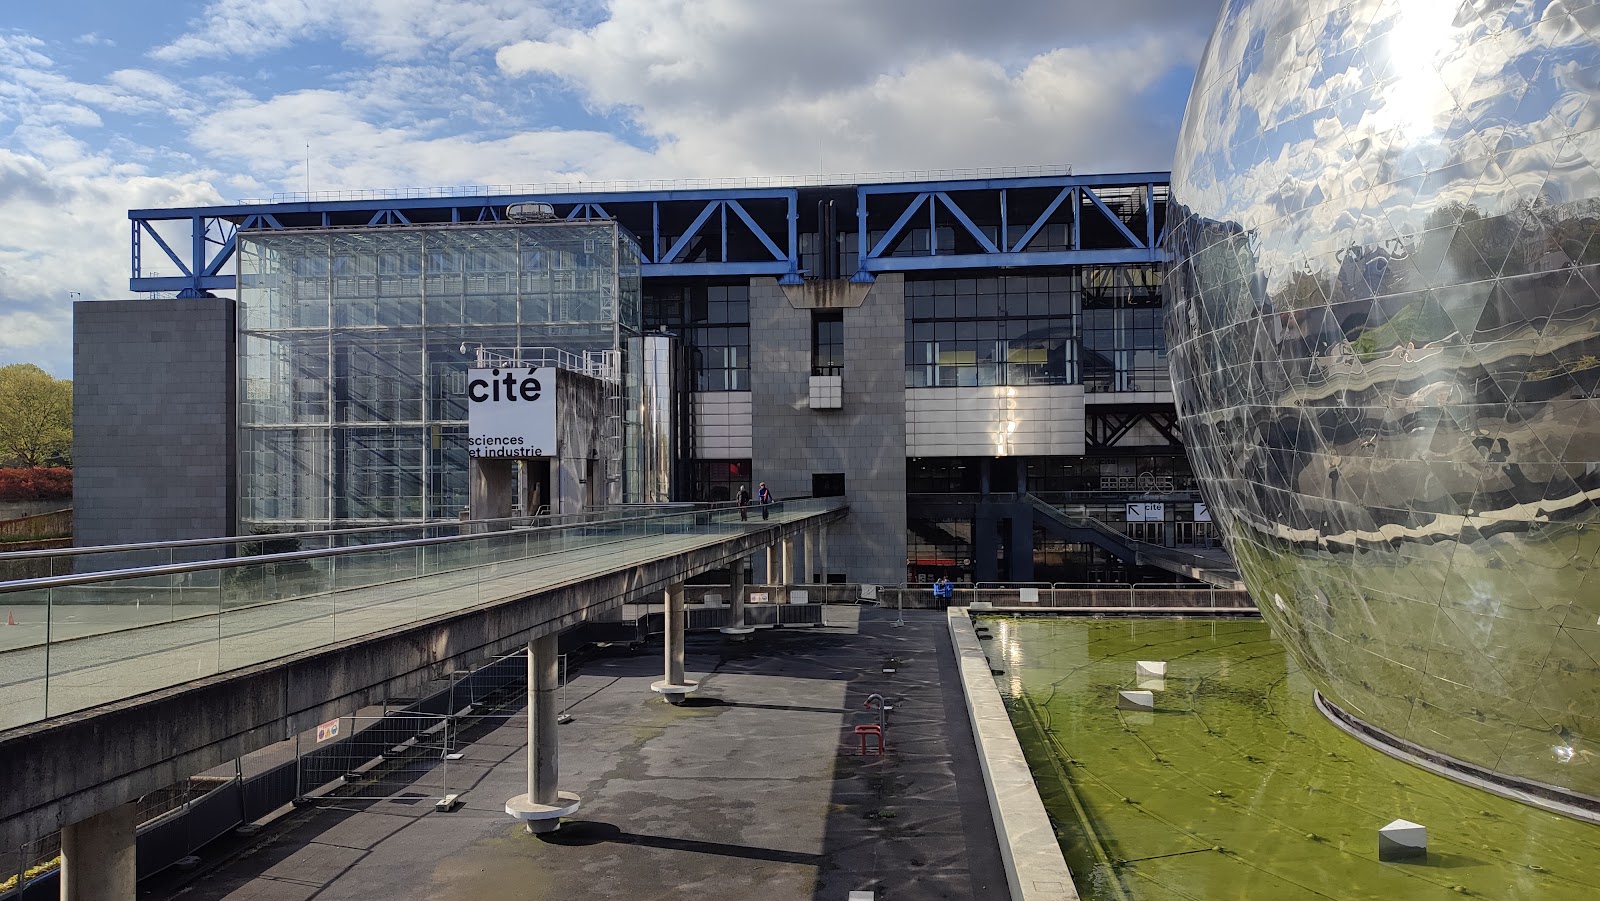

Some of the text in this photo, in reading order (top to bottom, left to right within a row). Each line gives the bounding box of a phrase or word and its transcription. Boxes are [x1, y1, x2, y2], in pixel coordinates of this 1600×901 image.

[469, 368, 541, 402] cité
[469, 434, 524, 446] sciences
[469, 445, 542, 458] et industrie
[1145, 502, 1162, 511] cité
